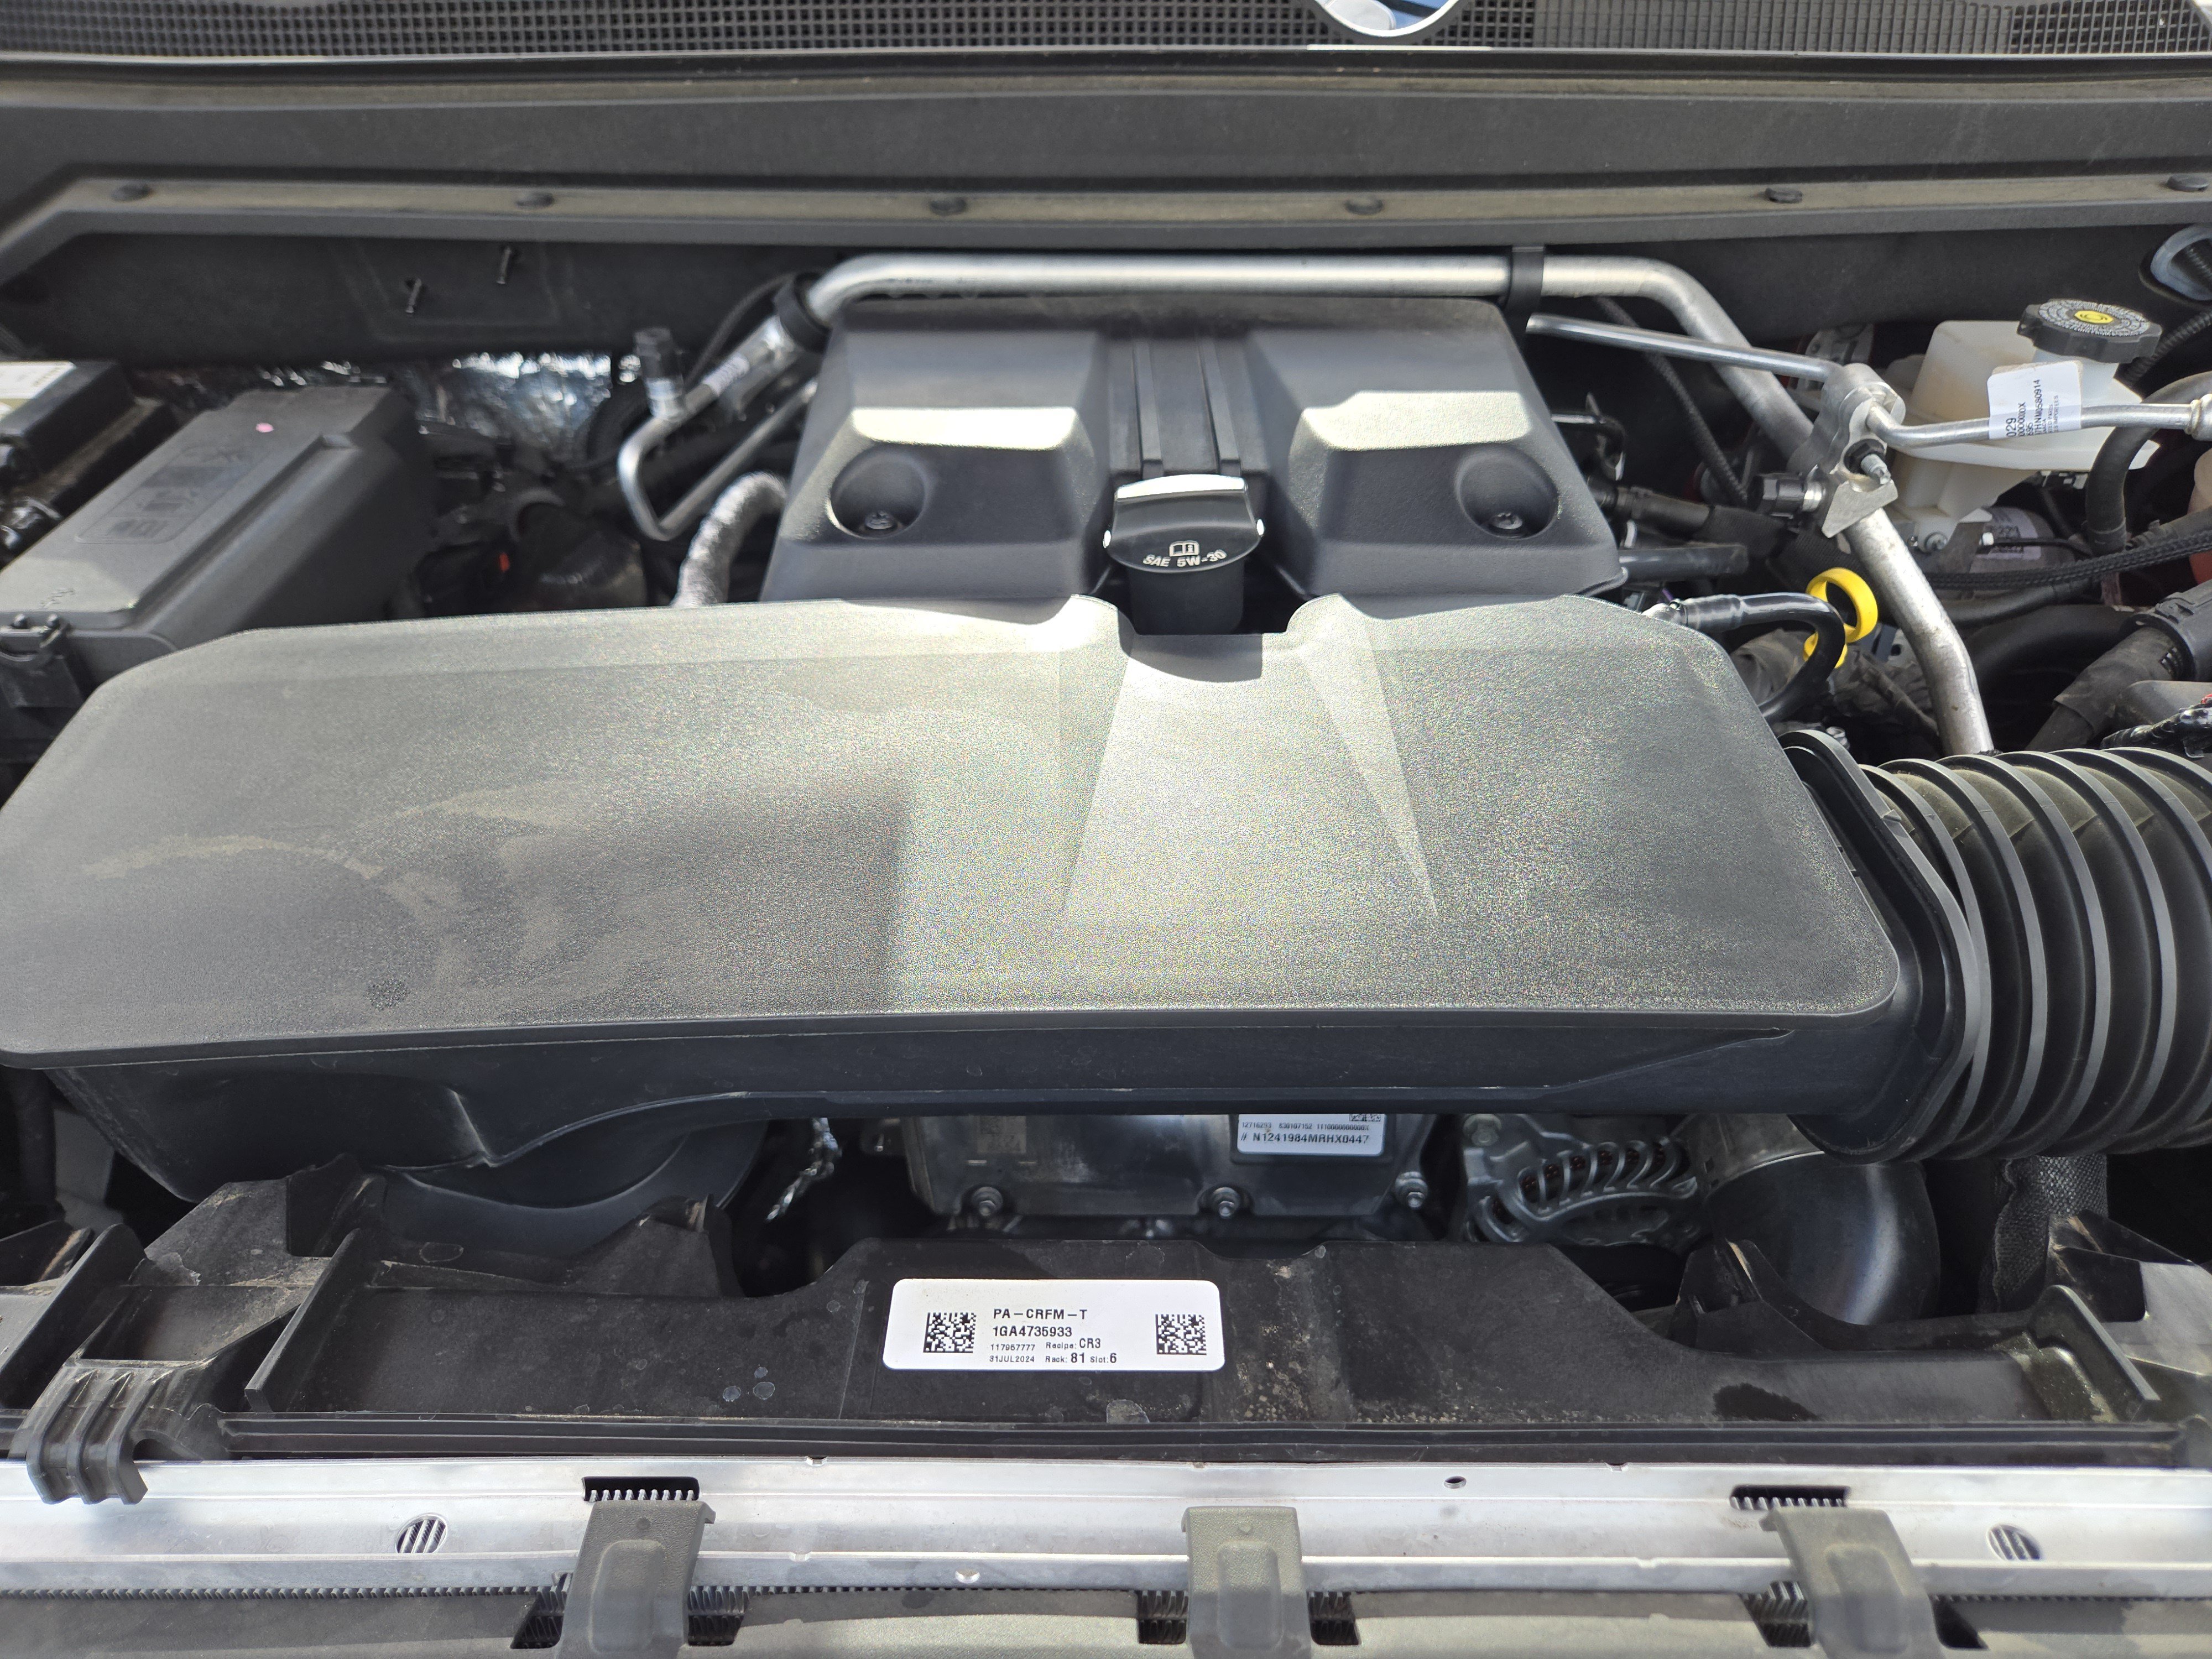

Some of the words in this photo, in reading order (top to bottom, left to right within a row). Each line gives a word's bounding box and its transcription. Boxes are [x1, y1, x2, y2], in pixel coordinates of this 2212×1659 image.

[1143, 554, 1171, 567] SAE
[1177, 549, 1227, 567] 5W-30
[993, 1326, 1072, 1337] 1GA4735933
[1079, 1338, 1101, 1349] CR3
[1071, 1352, 1085, 1364] 81
